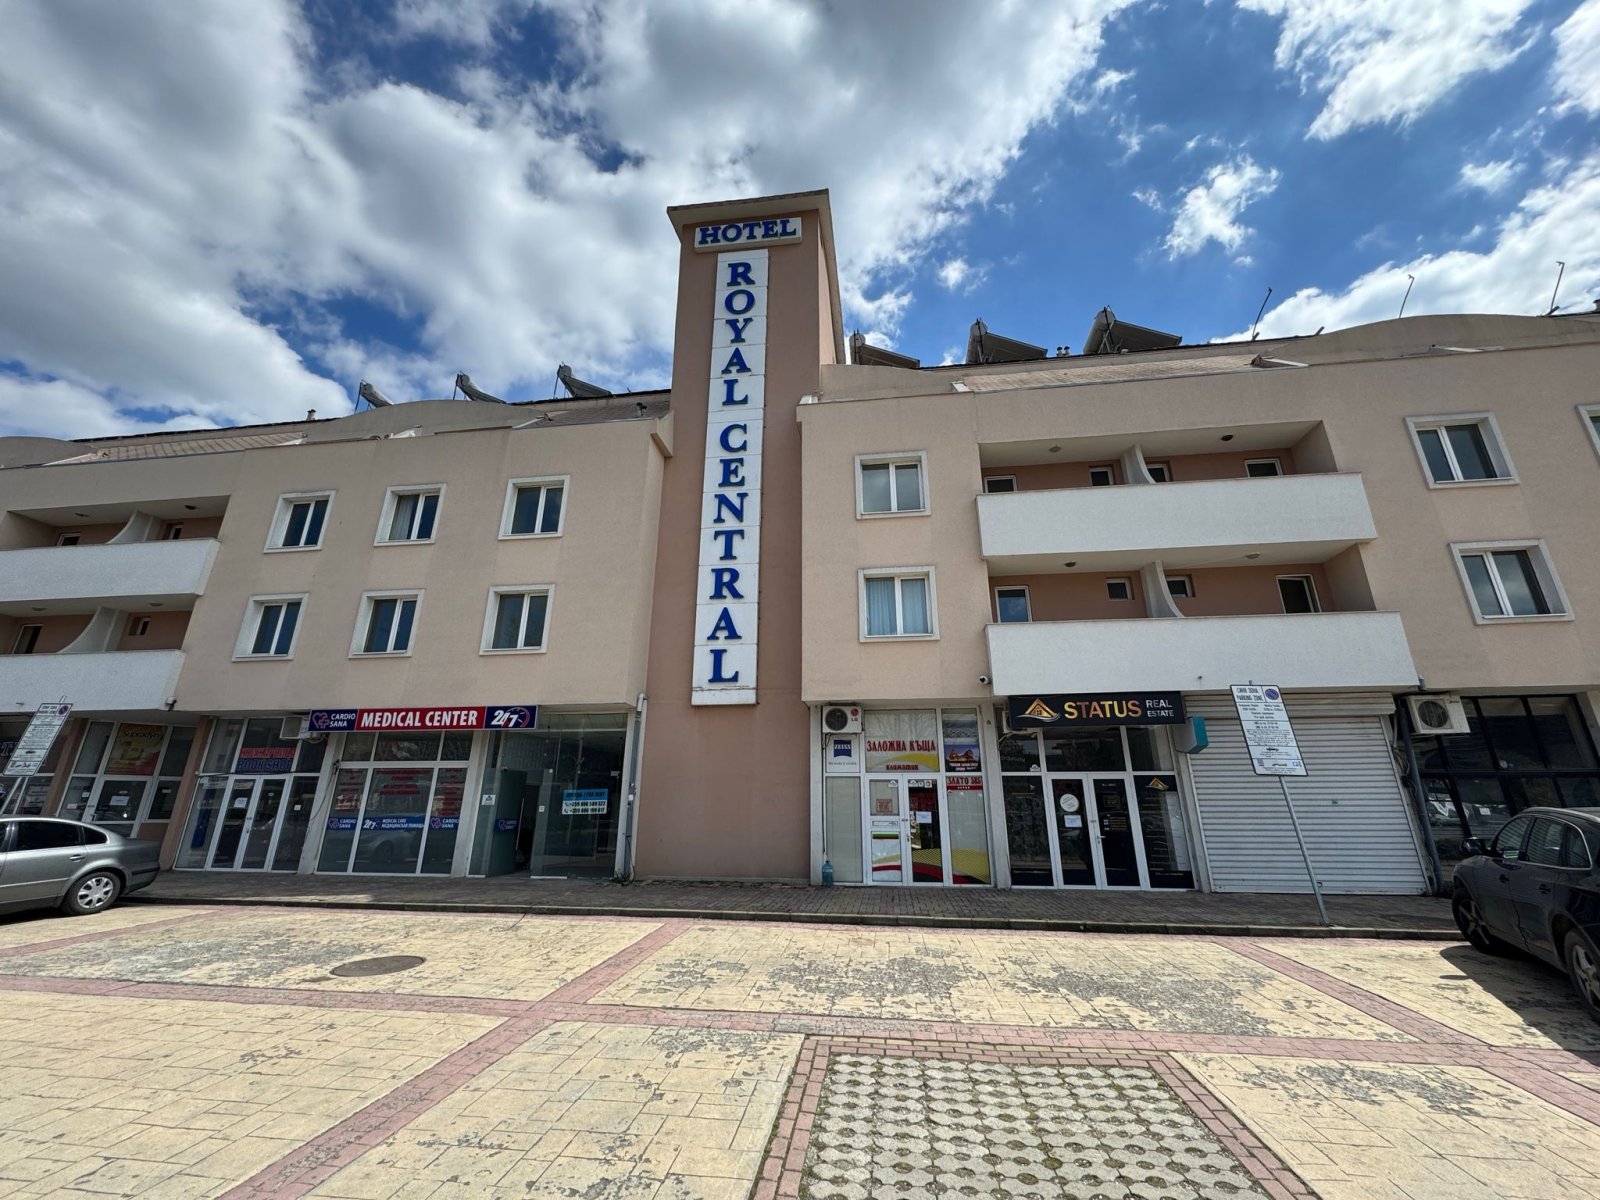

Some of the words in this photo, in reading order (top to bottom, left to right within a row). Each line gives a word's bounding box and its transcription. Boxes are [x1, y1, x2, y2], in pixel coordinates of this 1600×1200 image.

[698, 219, 797, 245] HOTEL
[721, 261, 756, 406] ROYAL
[707, 423, 749, 684] CENTRAL
[1063, 700, 1142, 719] STATUS
[1145, 699, 1173, 708] REAL
[360, 711, 421, 728] MEDICAL
[424, 710, 478, 727] CENTER
[1146, 709, 1175, 718] ESTATE
[329, 720, 348, 728] SANA
[866, 740, 907, 752] ЗАЛОЖНА
[909, 740, 936, 752] КЪЩА
[948, 777, 969, 785] ЗЛАТО
